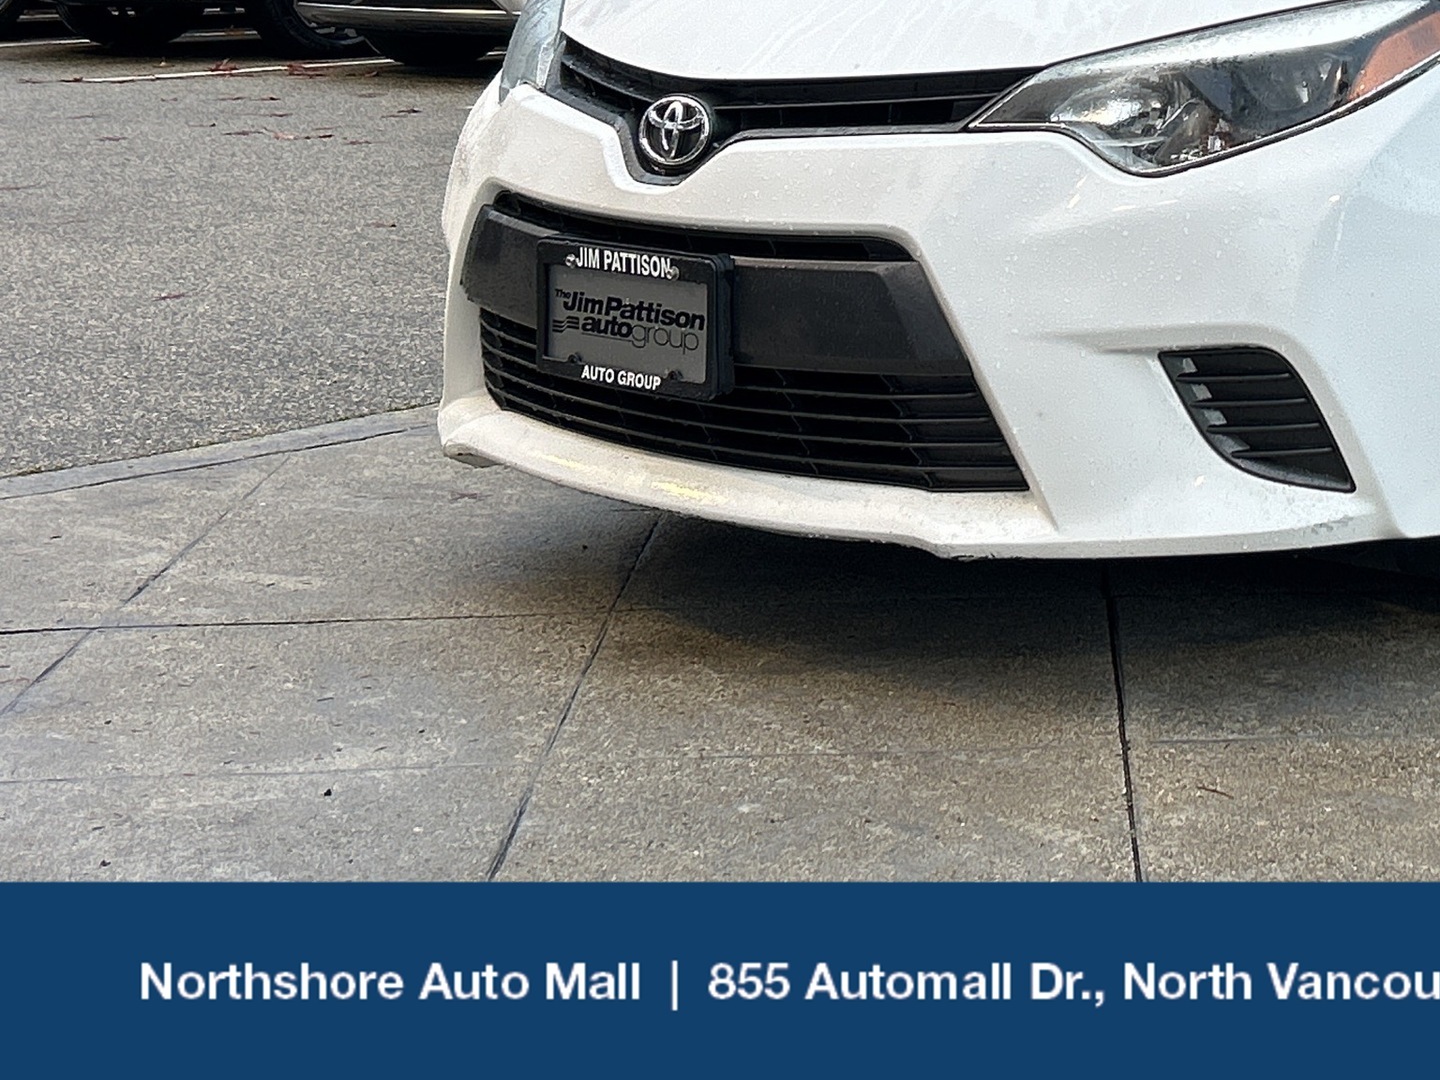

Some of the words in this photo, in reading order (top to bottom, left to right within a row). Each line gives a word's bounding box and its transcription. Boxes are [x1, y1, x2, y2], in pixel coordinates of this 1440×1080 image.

[575, 246, 601, 270] JIM
[603, 249, 673, 280] PATTISON
[554, 288, 572, 300] The
[581, 364, 615, 384] AUTO
[617, 370, 662, 391] GROUP
